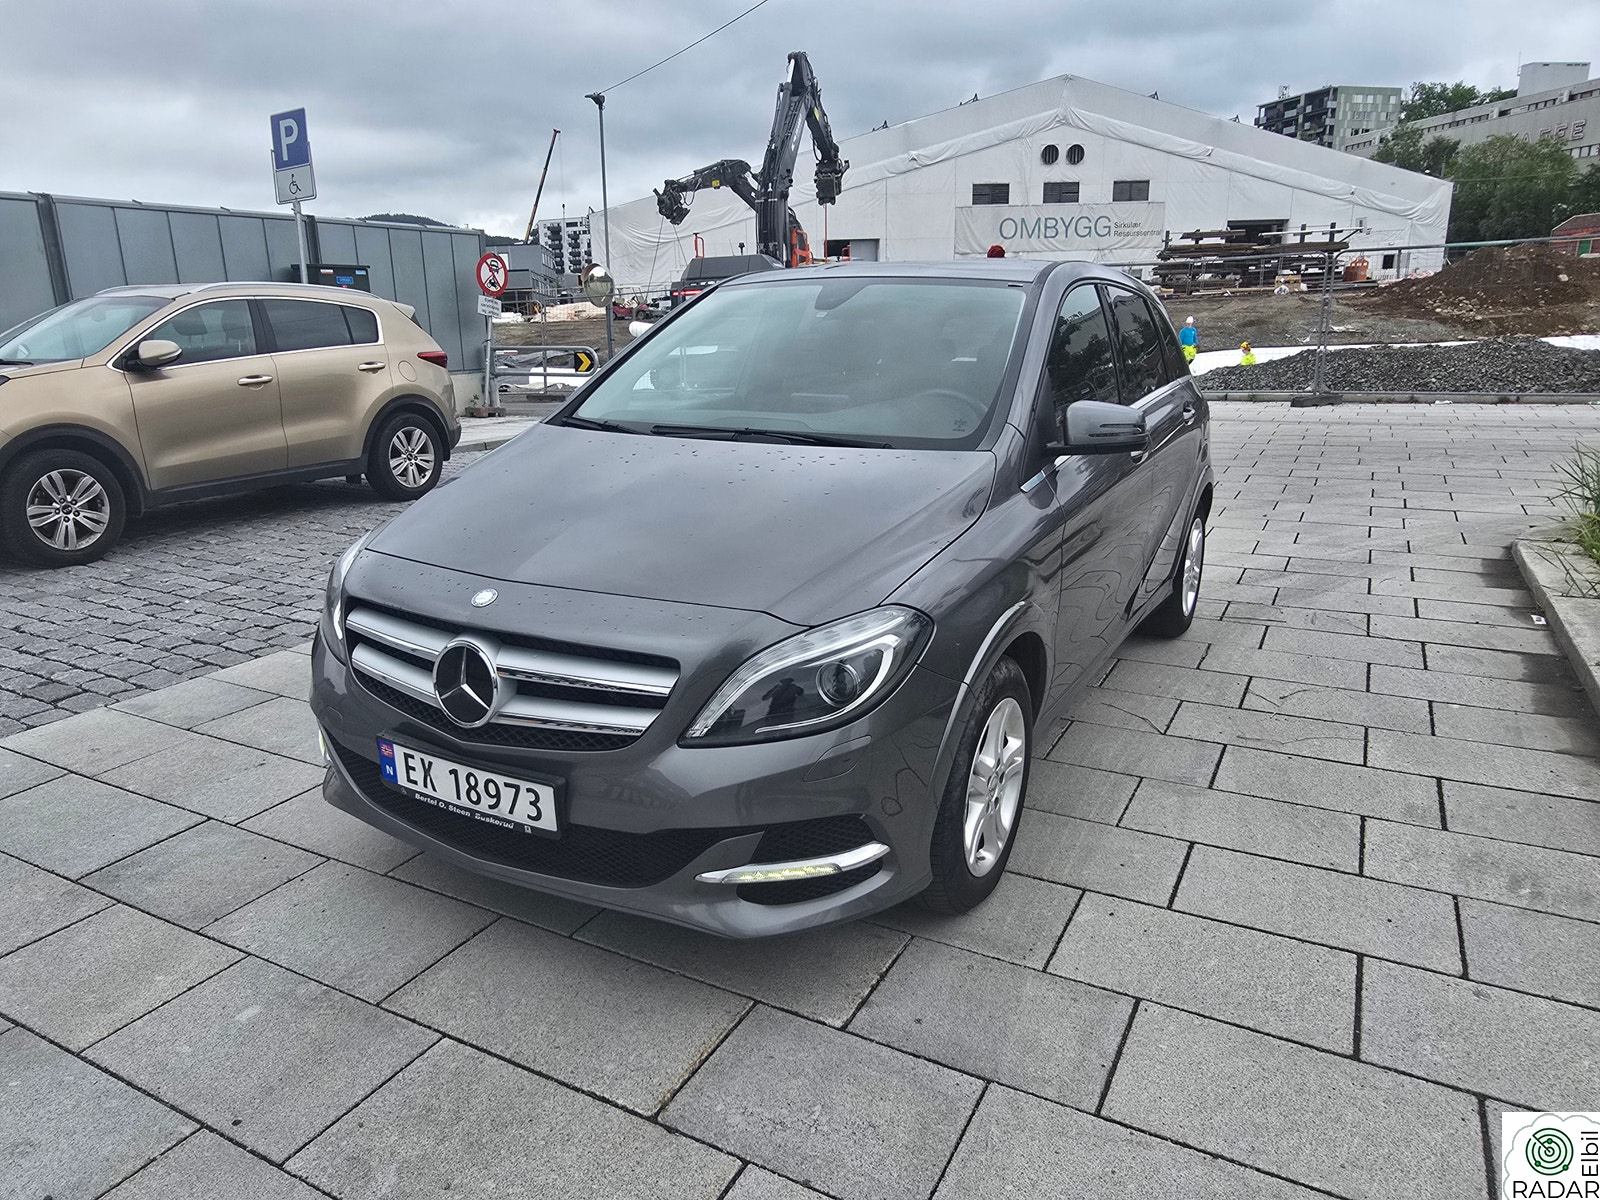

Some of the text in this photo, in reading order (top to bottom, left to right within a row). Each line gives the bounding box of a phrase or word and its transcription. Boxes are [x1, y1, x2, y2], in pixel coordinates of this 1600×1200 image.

[279, 118, 299, 161] P
[999, 215, 1112, 240] OMBYGG
[1113, 221, 1142, 229] Sirkulær
[1113, 229, 1162, 237] Ressurssentral
[385, 764, 394, 776] N
[415, 793, 437, 806] Bertel
[438, 801, 447, 809] O.
[448, 804, 471, 817] Steen
[448, 768, 543, 822] 18973
